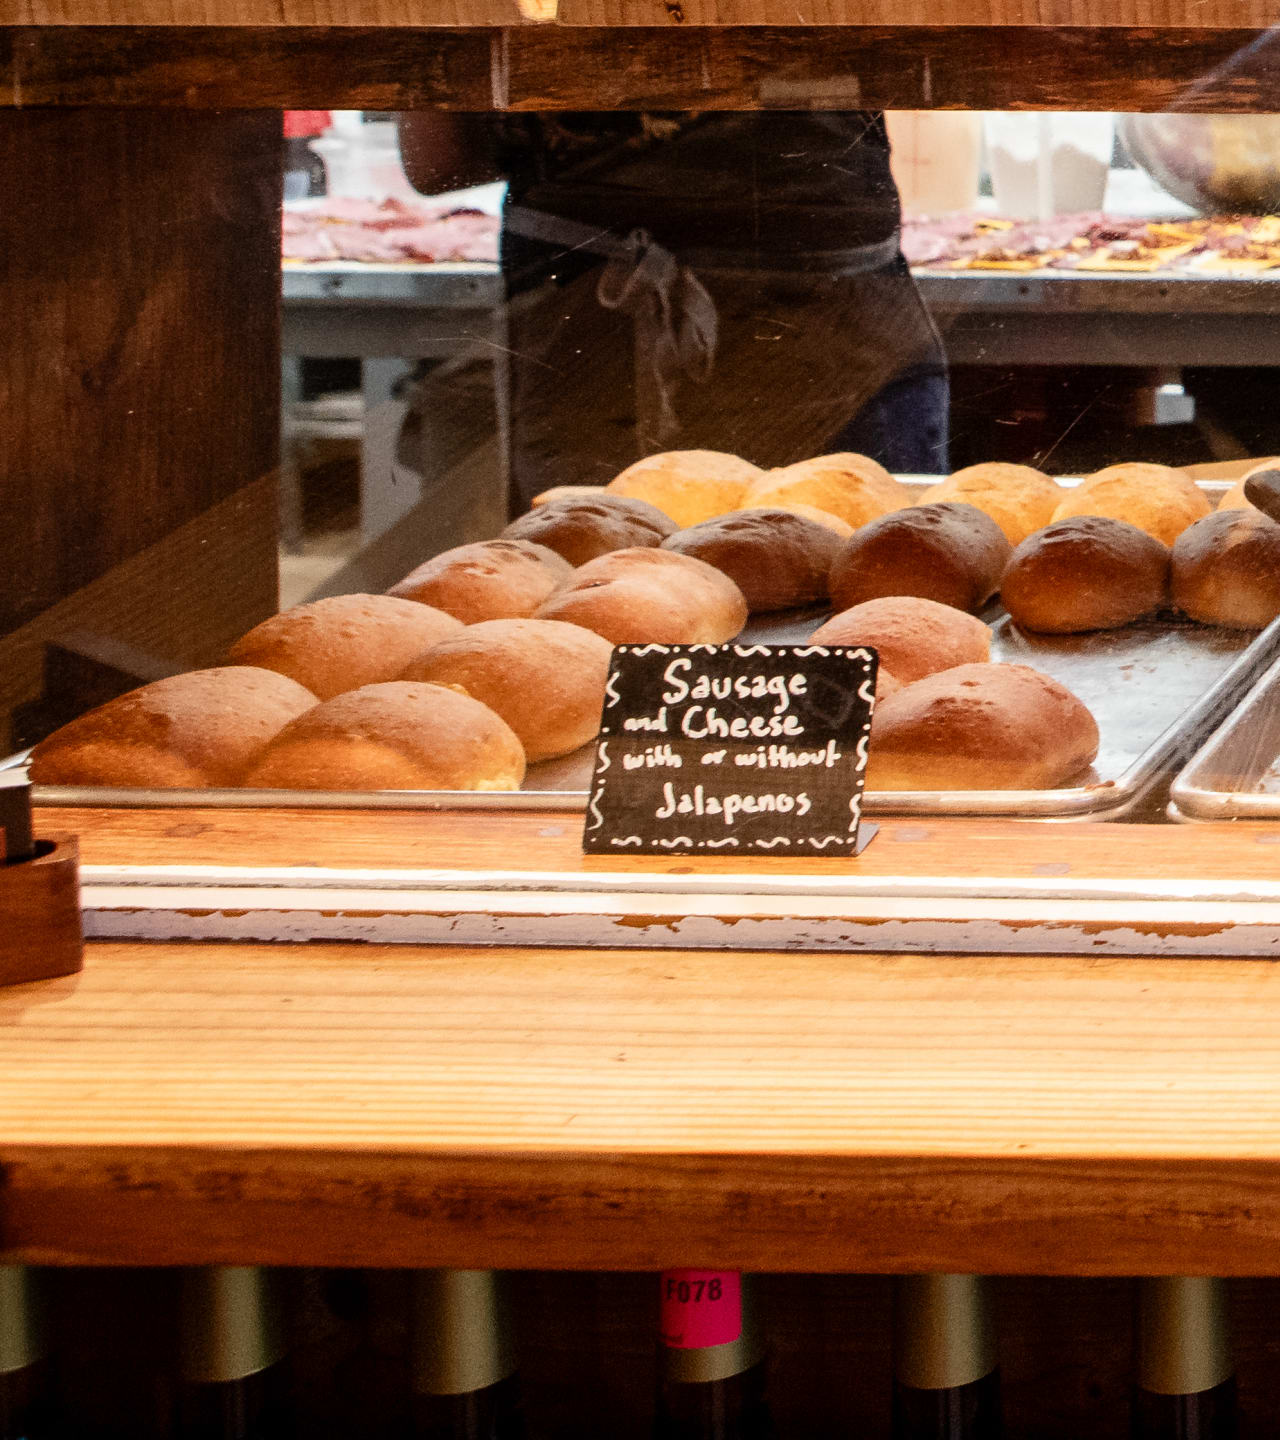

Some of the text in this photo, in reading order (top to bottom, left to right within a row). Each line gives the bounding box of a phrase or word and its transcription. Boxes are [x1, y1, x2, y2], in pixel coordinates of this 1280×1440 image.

[662, 658, 807, 714] Sausage
[623, 705, 804, 738] and Cheese
[622, 739, 841, 770] with or without
[655, 781, 811, 824] Jalapenos
